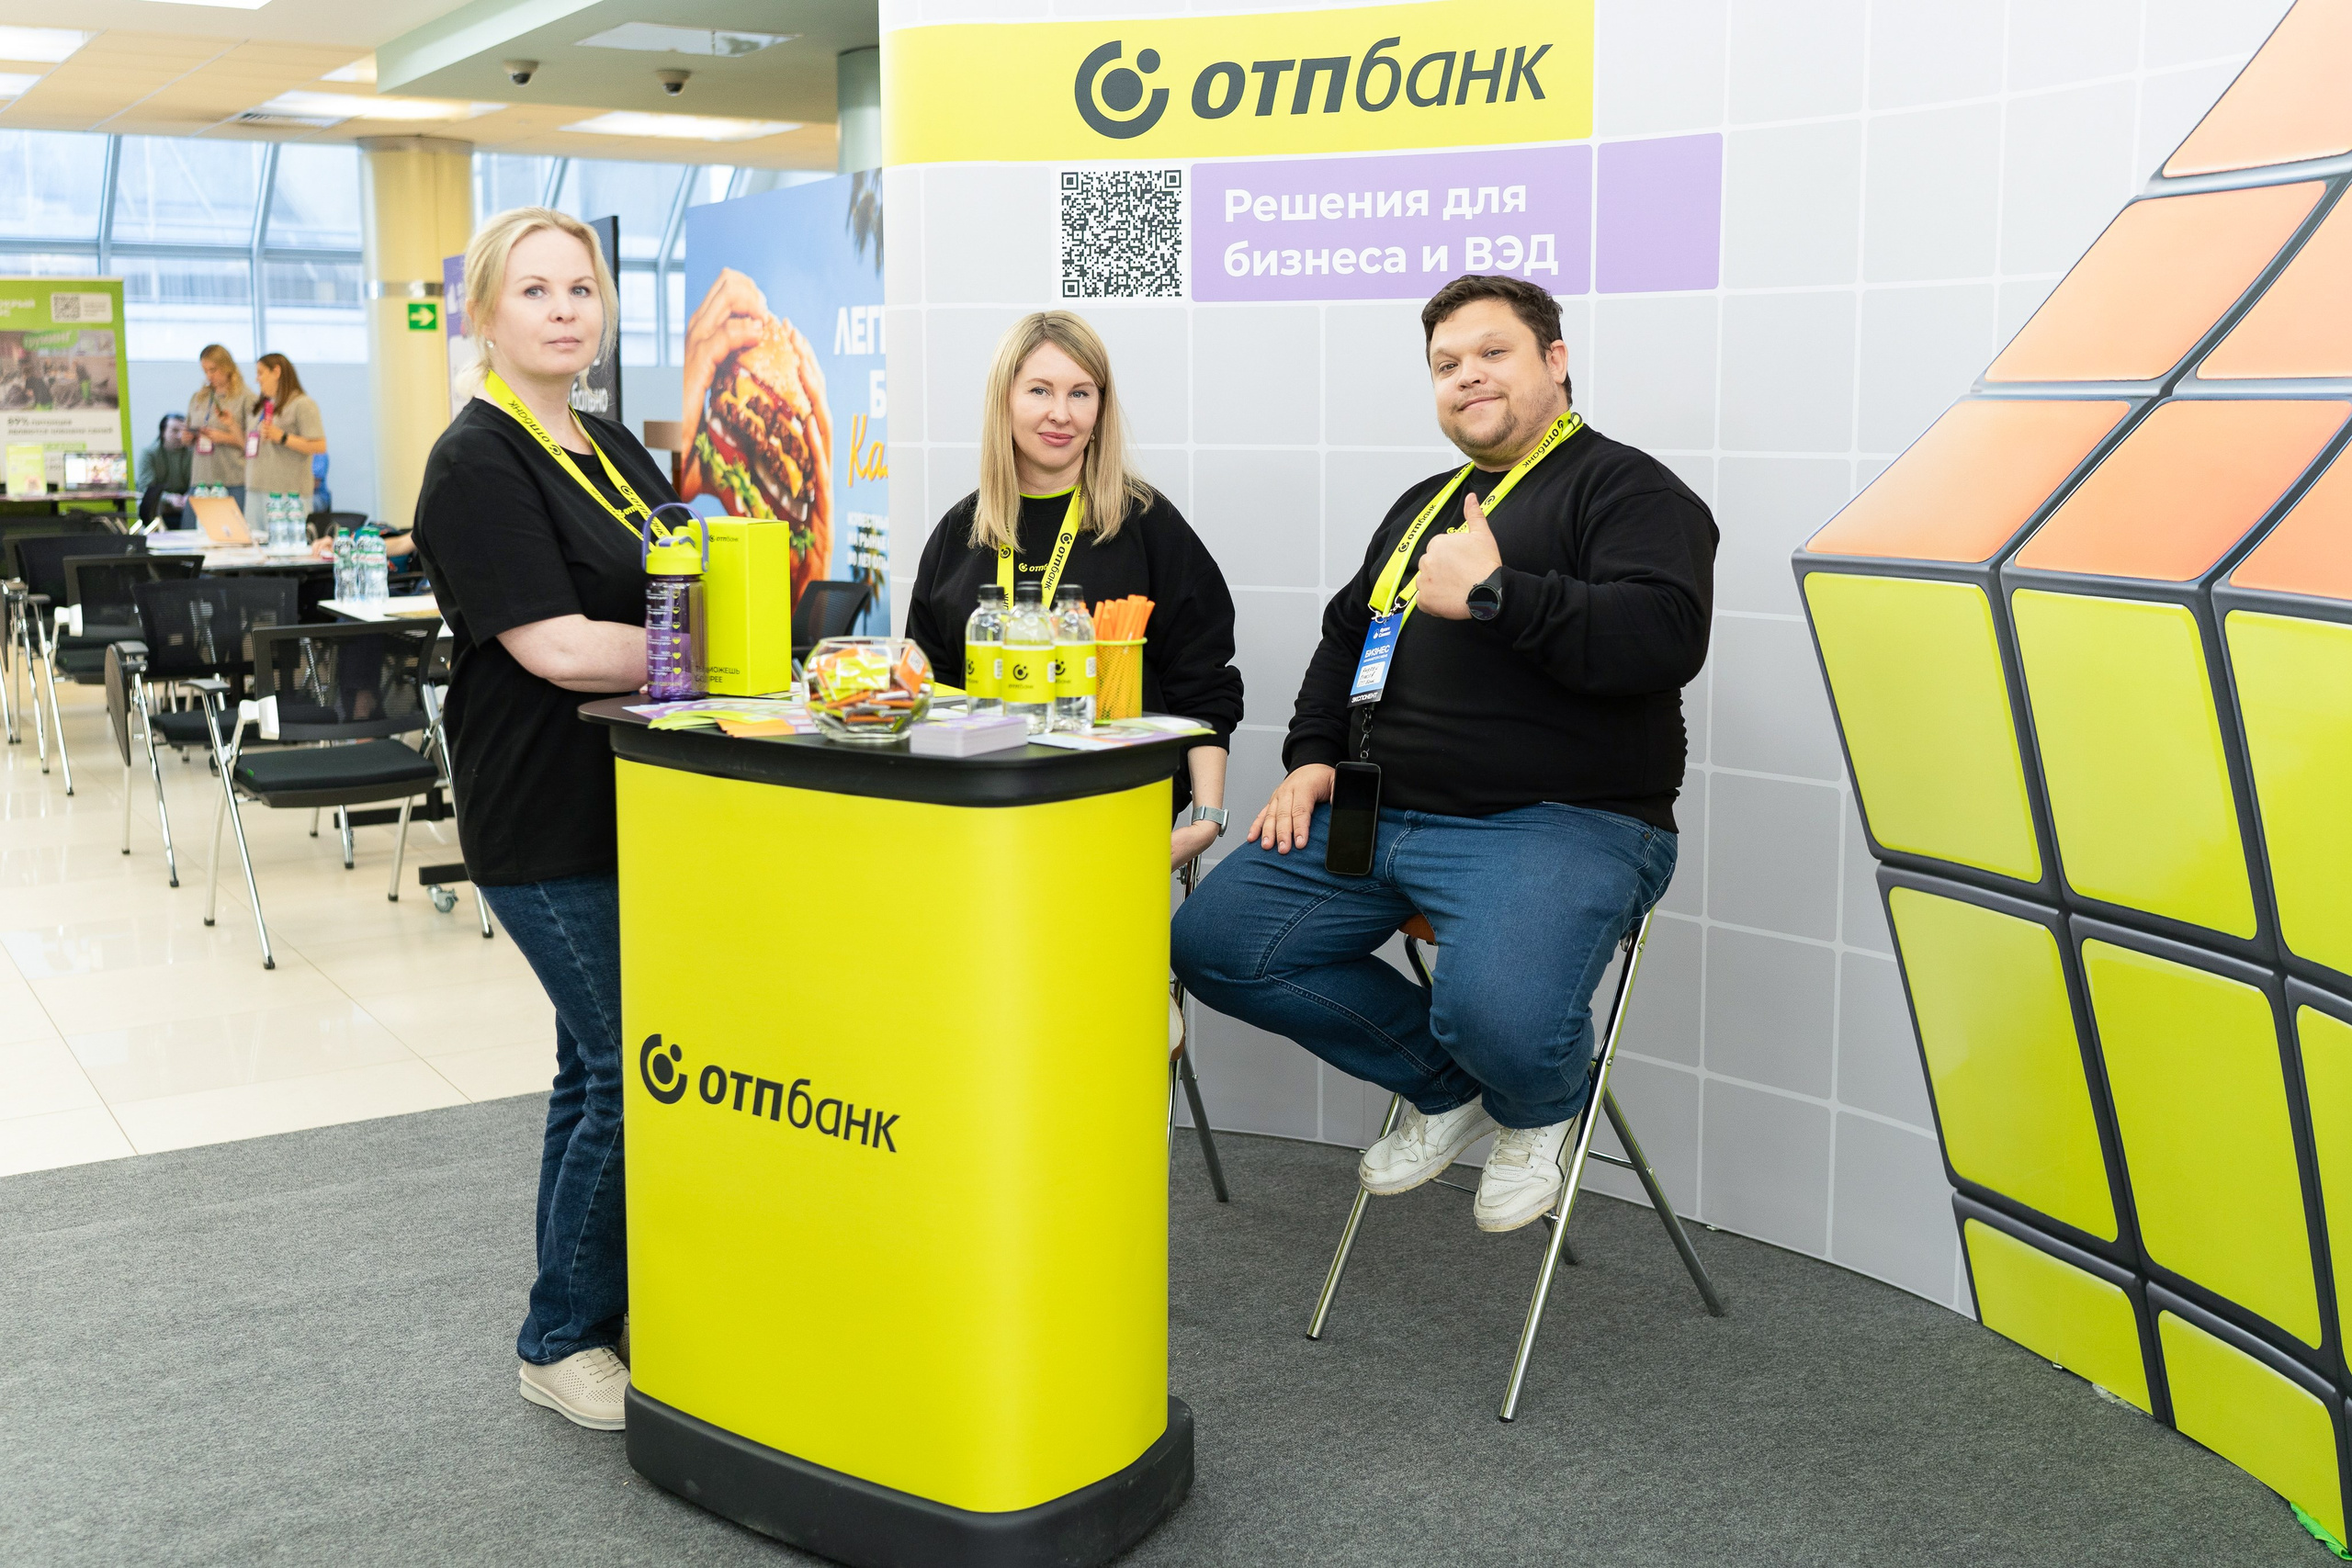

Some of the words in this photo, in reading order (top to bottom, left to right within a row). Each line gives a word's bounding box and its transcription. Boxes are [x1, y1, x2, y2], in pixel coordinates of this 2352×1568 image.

[1225, 188, 1430, 223] Решения
[1442, 185, 1527, 221] для
[1223, 240, 1407, 277] бизнеса
[1421, 244, 1449, 273] и
[1464, 233, 1559, 276] ВЭД
